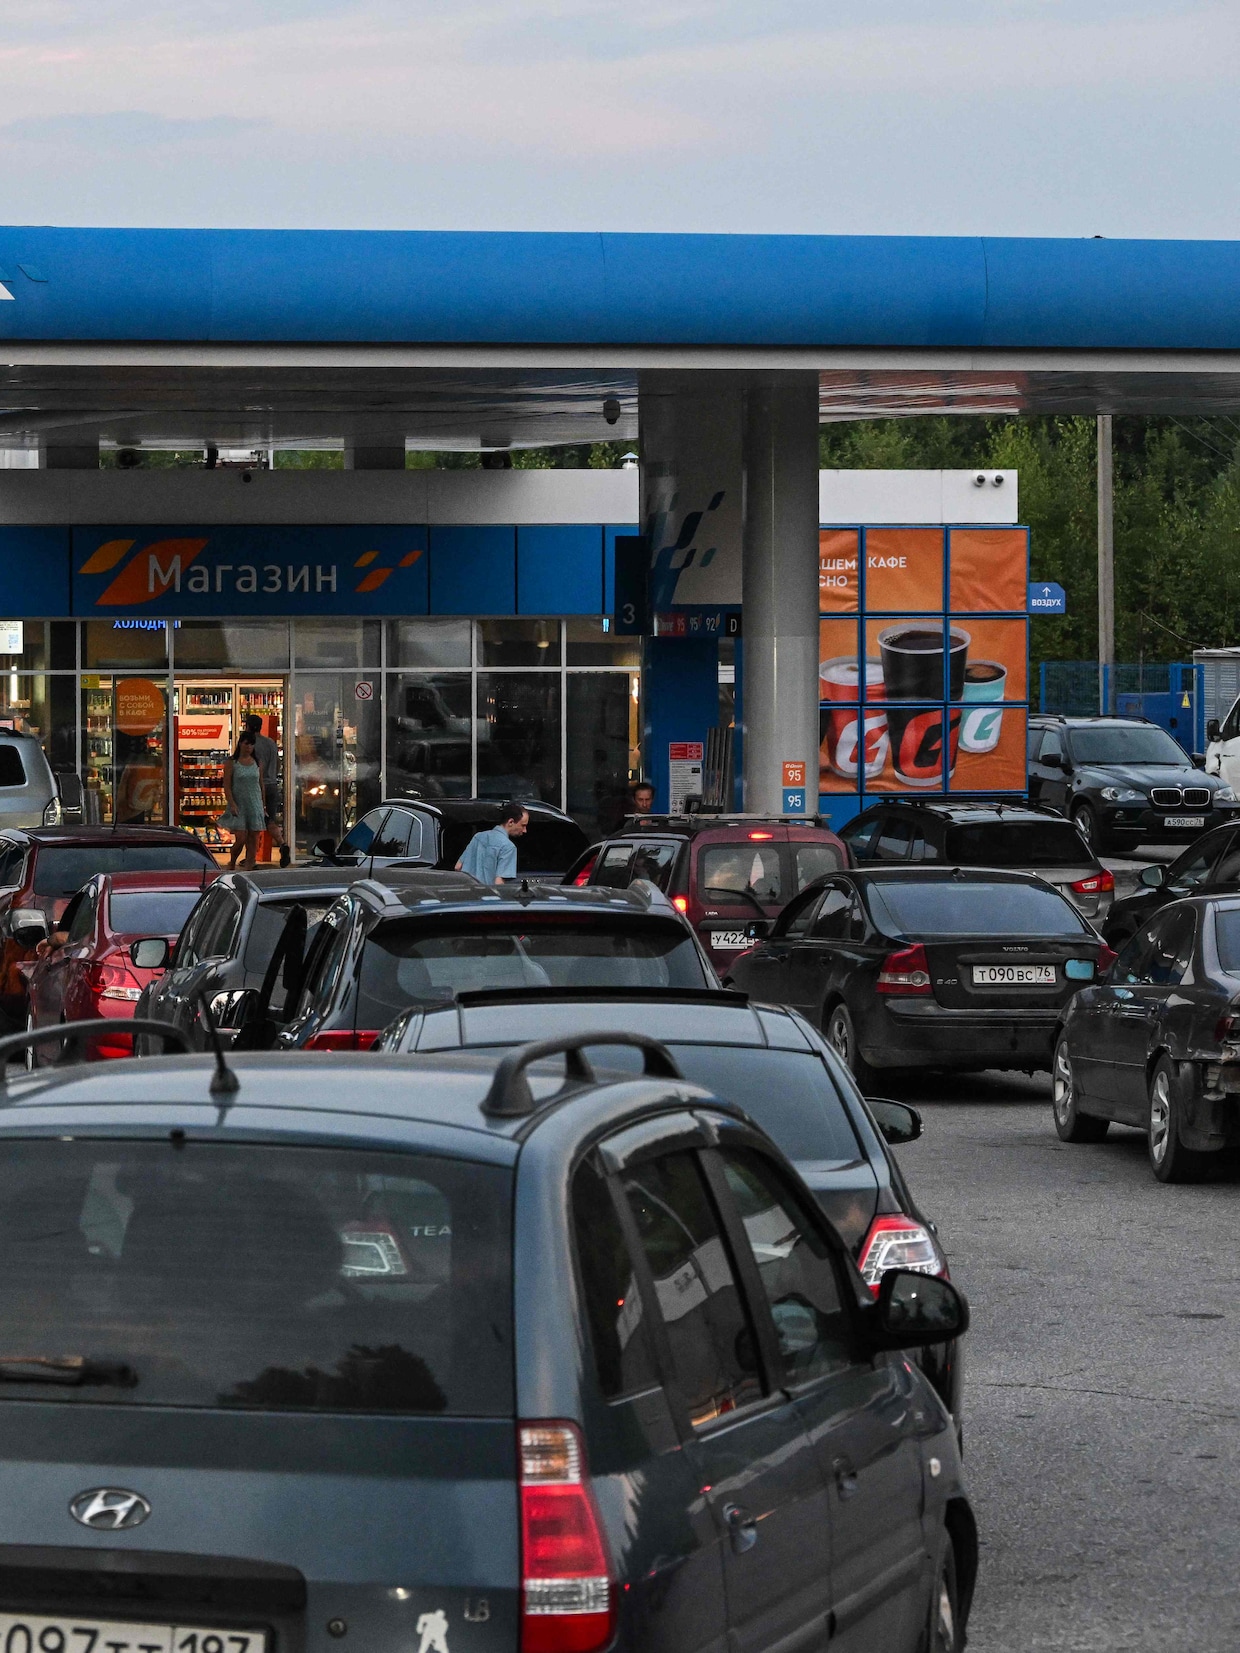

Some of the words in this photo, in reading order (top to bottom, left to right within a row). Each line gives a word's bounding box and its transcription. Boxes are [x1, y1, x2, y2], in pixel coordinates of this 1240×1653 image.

[867, 556, 907, 569] КАФЕ
[148, 554, 337, 593] Магазин
[1031, 599, 1061, 607] ВОЗДУХ
[622, 603, 636, 625] 3
[730, 618, 738, 632] D
[788, 770, 801, 781] 95
[788, 795, 801, 807] 95
[715, 932, 755, 944] У422Е
[978, 967, 1033, 981] Т090ВС
[1037, 967, 1051, 977] 76
